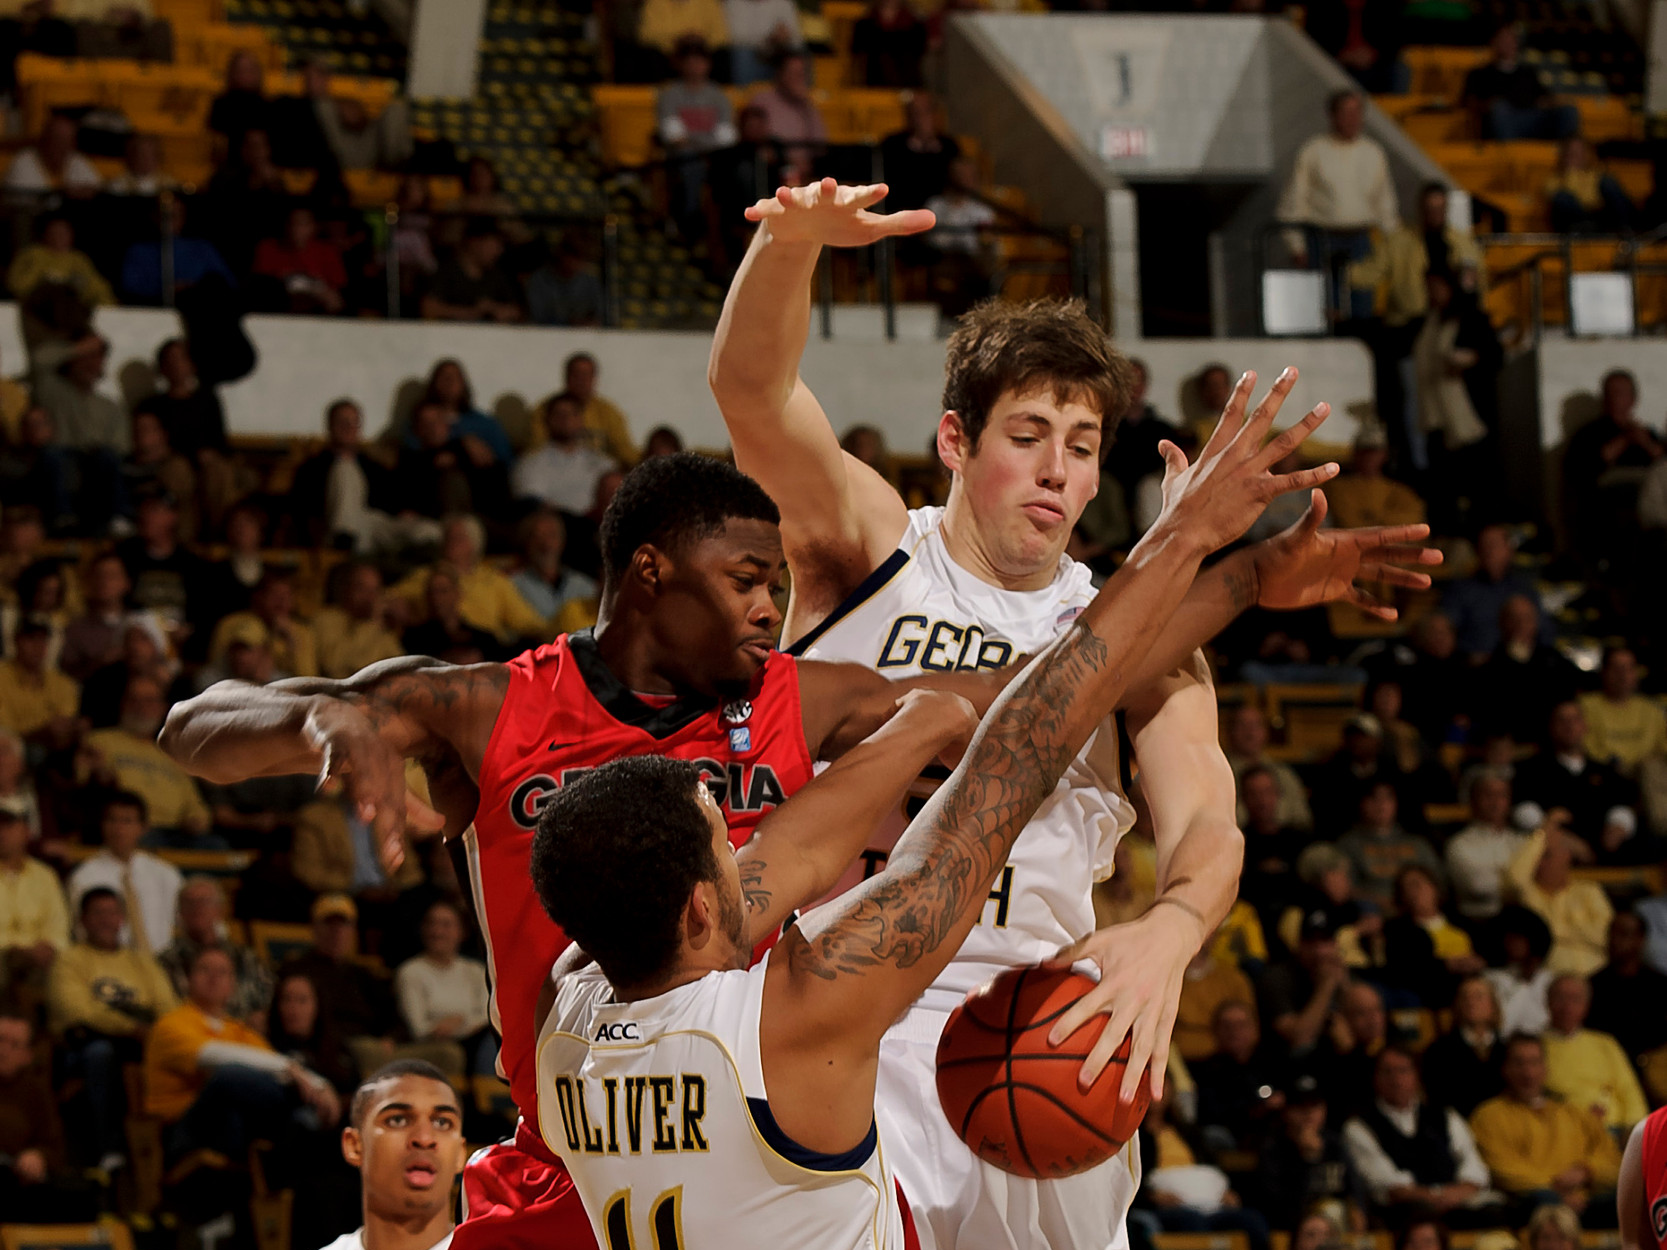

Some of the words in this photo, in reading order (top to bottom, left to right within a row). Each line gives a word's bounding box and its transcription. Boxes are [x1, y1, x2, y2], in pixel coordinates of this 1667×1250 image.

[876, 614, 1030, 672] GEOR
[510, 756, 788, 830] GGIA
[595, 1023, 639, 1042] ACC
[555, 1072, 710, 1156] OLIVER
